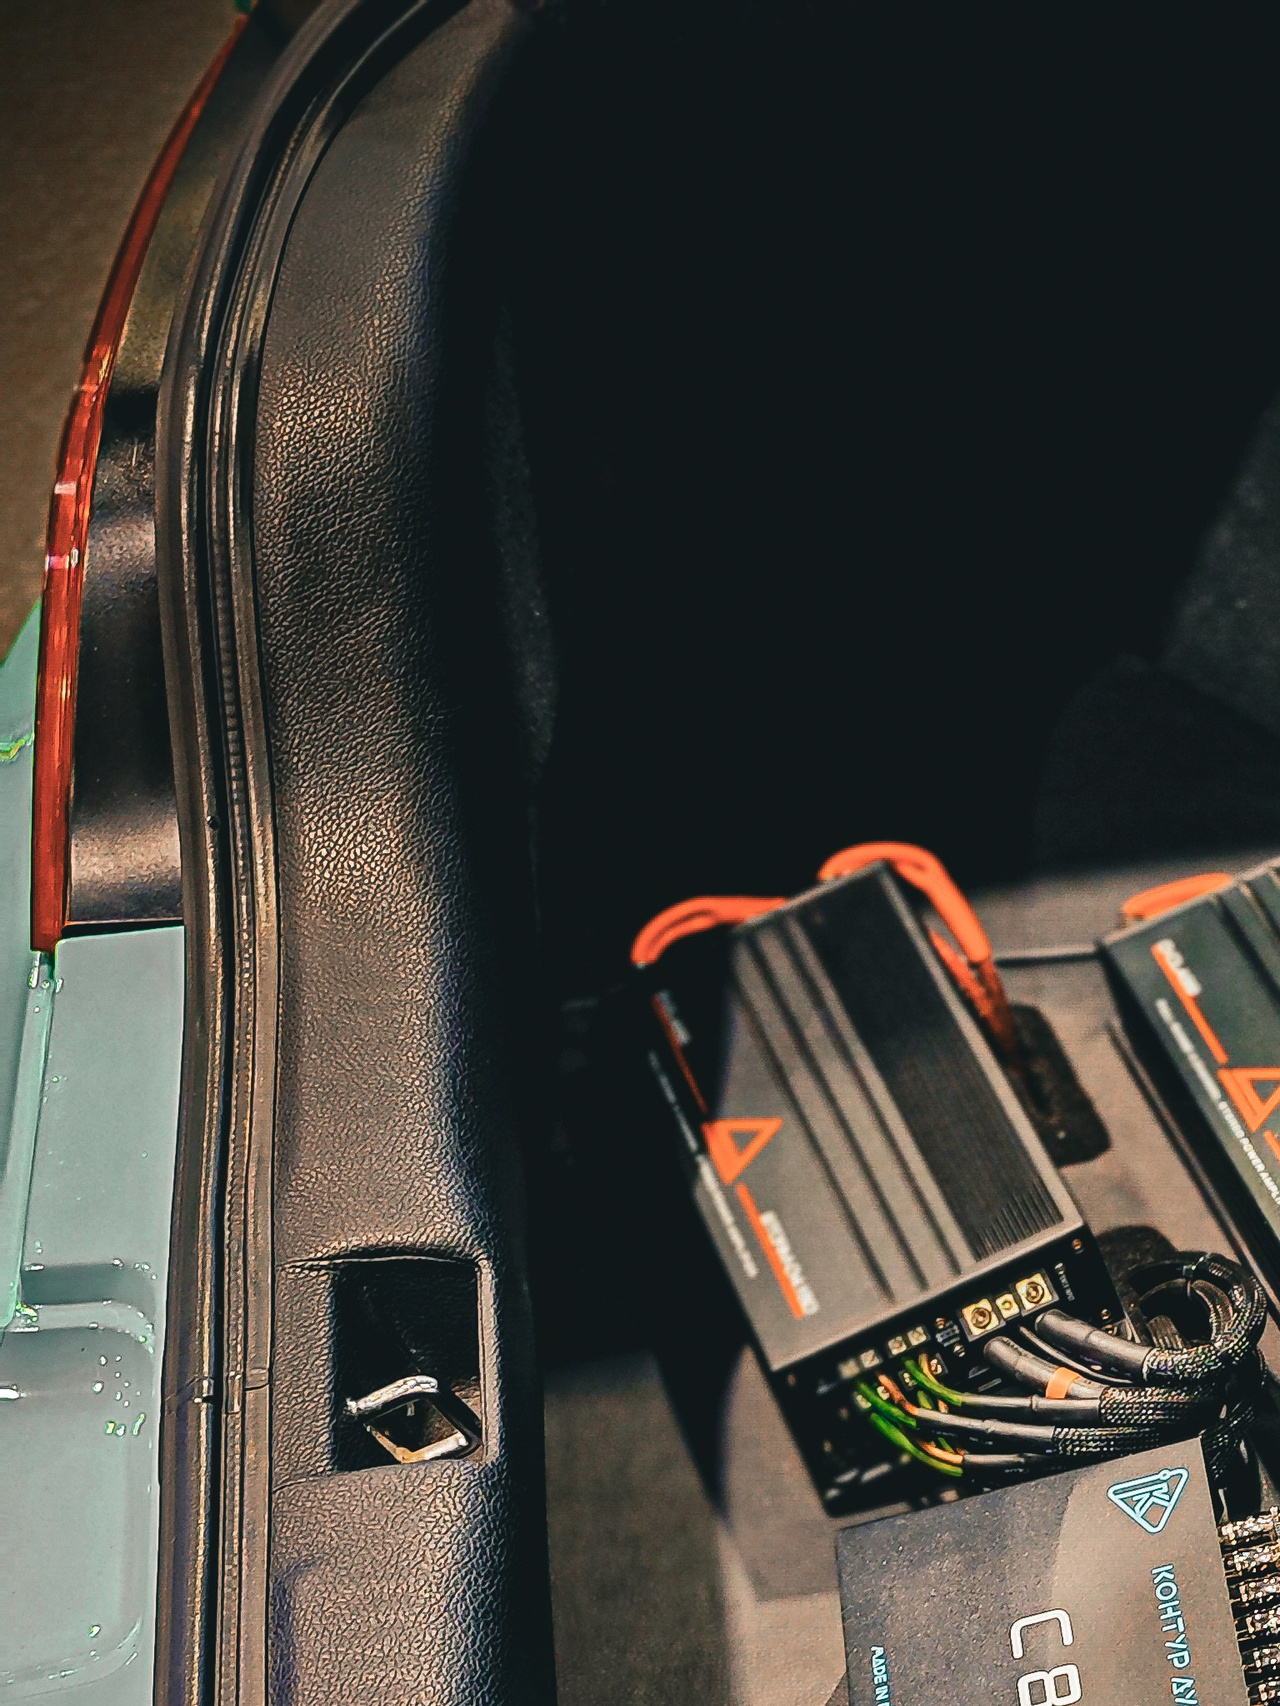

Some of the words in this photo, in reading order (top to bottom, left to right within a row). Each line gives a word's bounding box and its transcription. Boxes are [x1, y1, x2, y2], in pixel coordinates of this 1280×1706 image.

[1240, 1137, 1266, 1173] POWER
[1151, 1563, 1191, 1669] КОНТУР
[871, 1645, 887, 1685] MADE
[875, 1685, 889, 1701] IN
